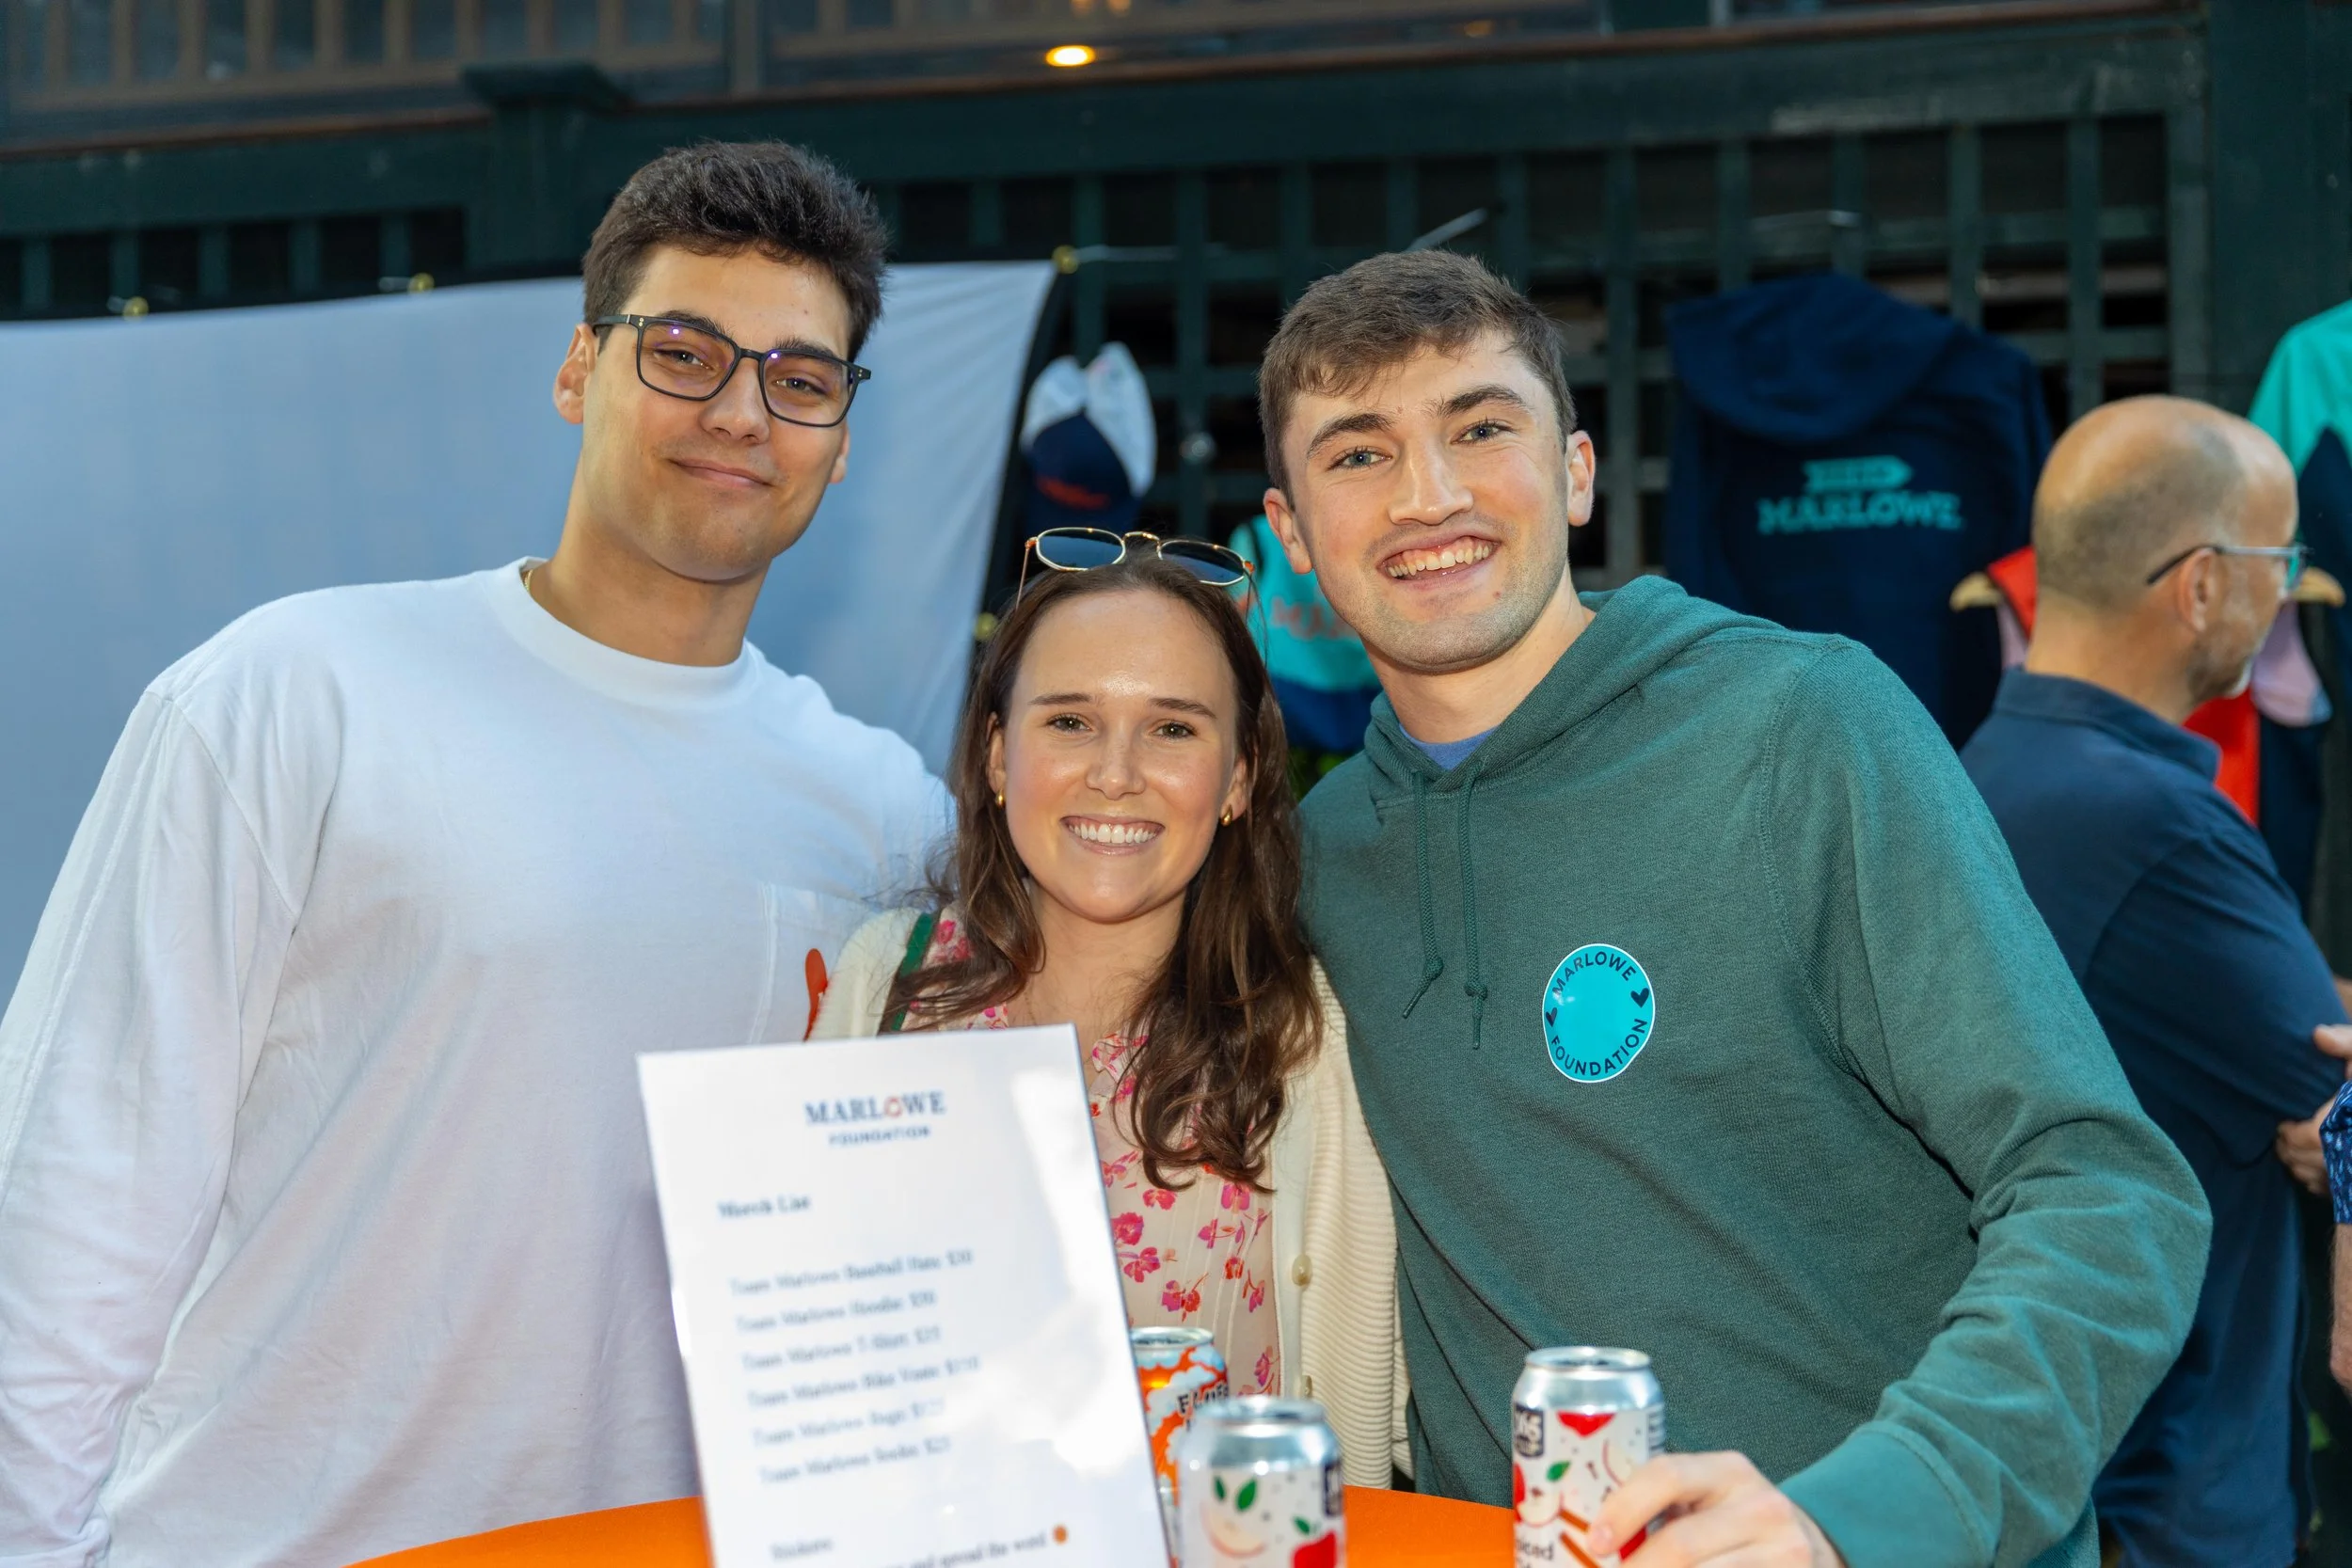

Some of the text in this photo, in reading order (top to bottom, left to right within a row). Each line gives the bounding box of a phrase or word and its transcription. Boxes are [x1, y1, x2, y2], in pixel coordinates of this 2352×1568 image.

[1756, 490, 1963, 535] MARLOWE
[1552, 951, 1636, 997] MARLOWE
[1551, 1019, 1647, 1076] FOUNDATION
[804, 1089, 946, 1125] MARLOWE
[829, 1126, 931, 1146] FOUNDATION
